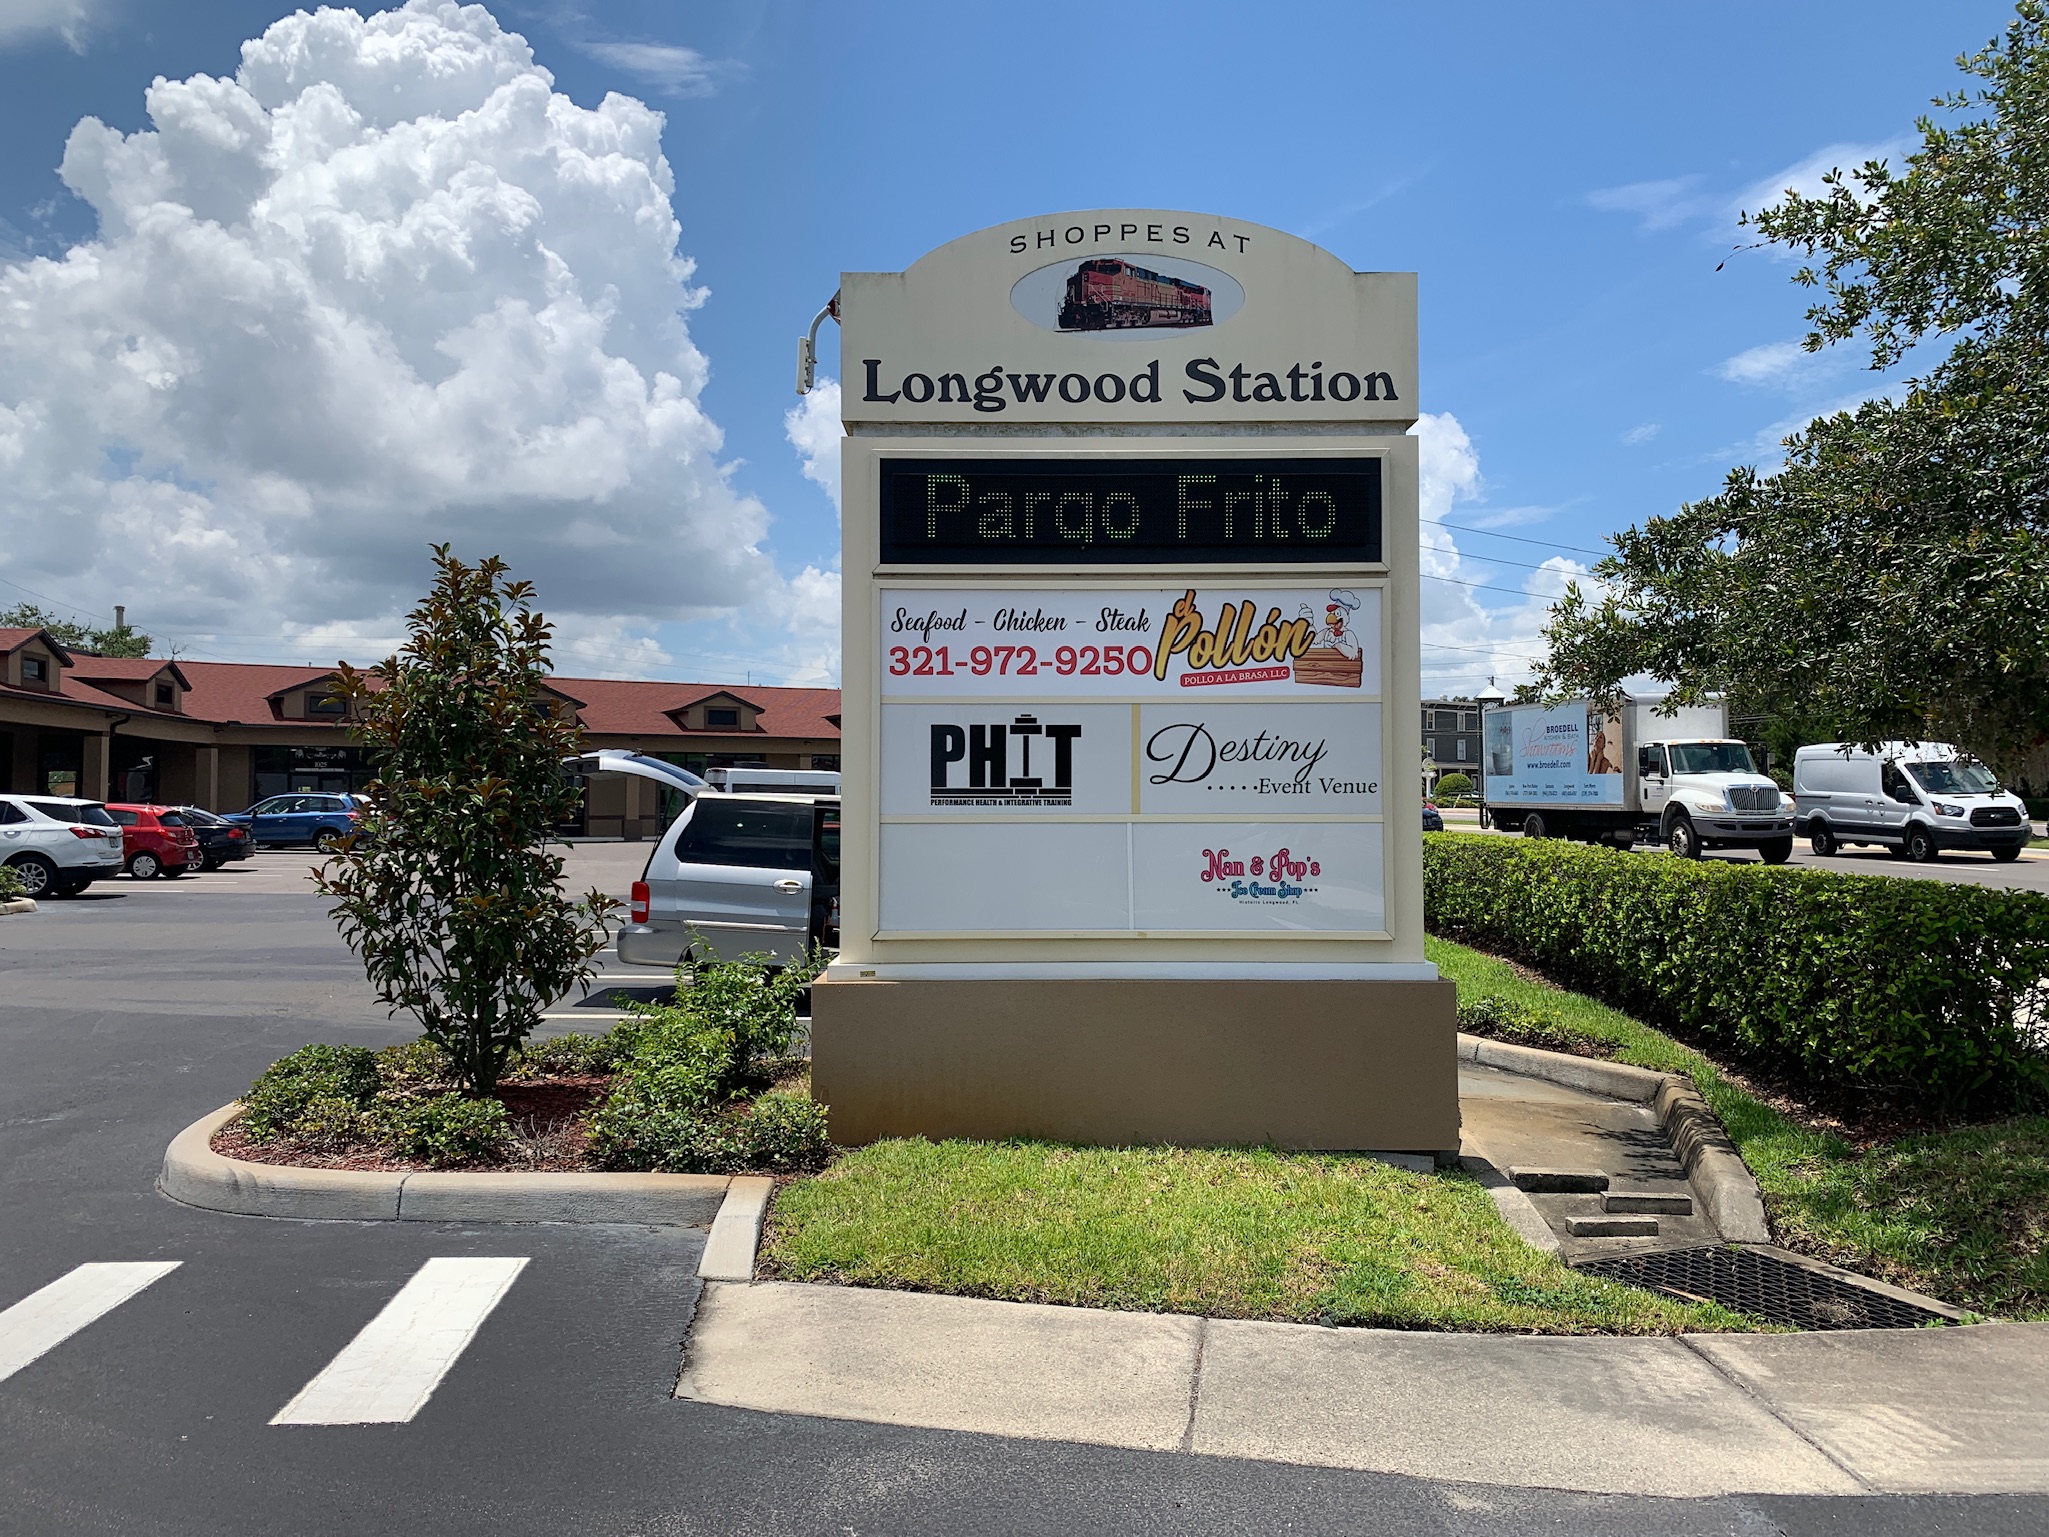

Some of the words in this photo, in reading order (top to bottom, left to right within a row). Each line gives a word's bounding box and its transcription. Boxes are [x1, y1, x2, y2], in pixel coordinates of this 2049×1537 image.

[1010, 223, 1191, 254] SHOPPES
[1207, 231, 1251, 254] AT
[862, 359, 1162, 412] Longwood
[1182, 357, 1399, 404] Station
[1176, 473, 1338, 540] Frito
[1173, 589, 1197, 618] el
[890, 607, 966, 643] Seafood
[993, 607, 1068, 632] Chicken
[1095, 607, 1152, 633] Steak
[1154, 600, 1316, 681] Pollón
[888, 645, 1154, 676] 321-972-9250
[1184, 674, 1215, 686] POLLO
[1216, 674, 1224, 684] A
[1225, 673, 1237, 683] LA
[1238, 671, 1268, 681] BRASA
[1270, 669, 1288, 679] LLC
[1546, 724, 1579, 734] BROEDELL
[930, 714, 1082, 788] PHIT
[1146, 723, 1329, 785] Destiny
[1527, 760, 1572, 769] www.broedell.com
[1319, 777, 1378, 794] Venue
[1200, 848, 1245, 883] Nan
[1249, 856, 1264, 876] &
[1269, 847, 1321, 883] Pop's
[1231, 880, 1248, 898] Ice
[1248, 881, 1277, 898] Cream
[1277, 880, 1303, 899] Shop
